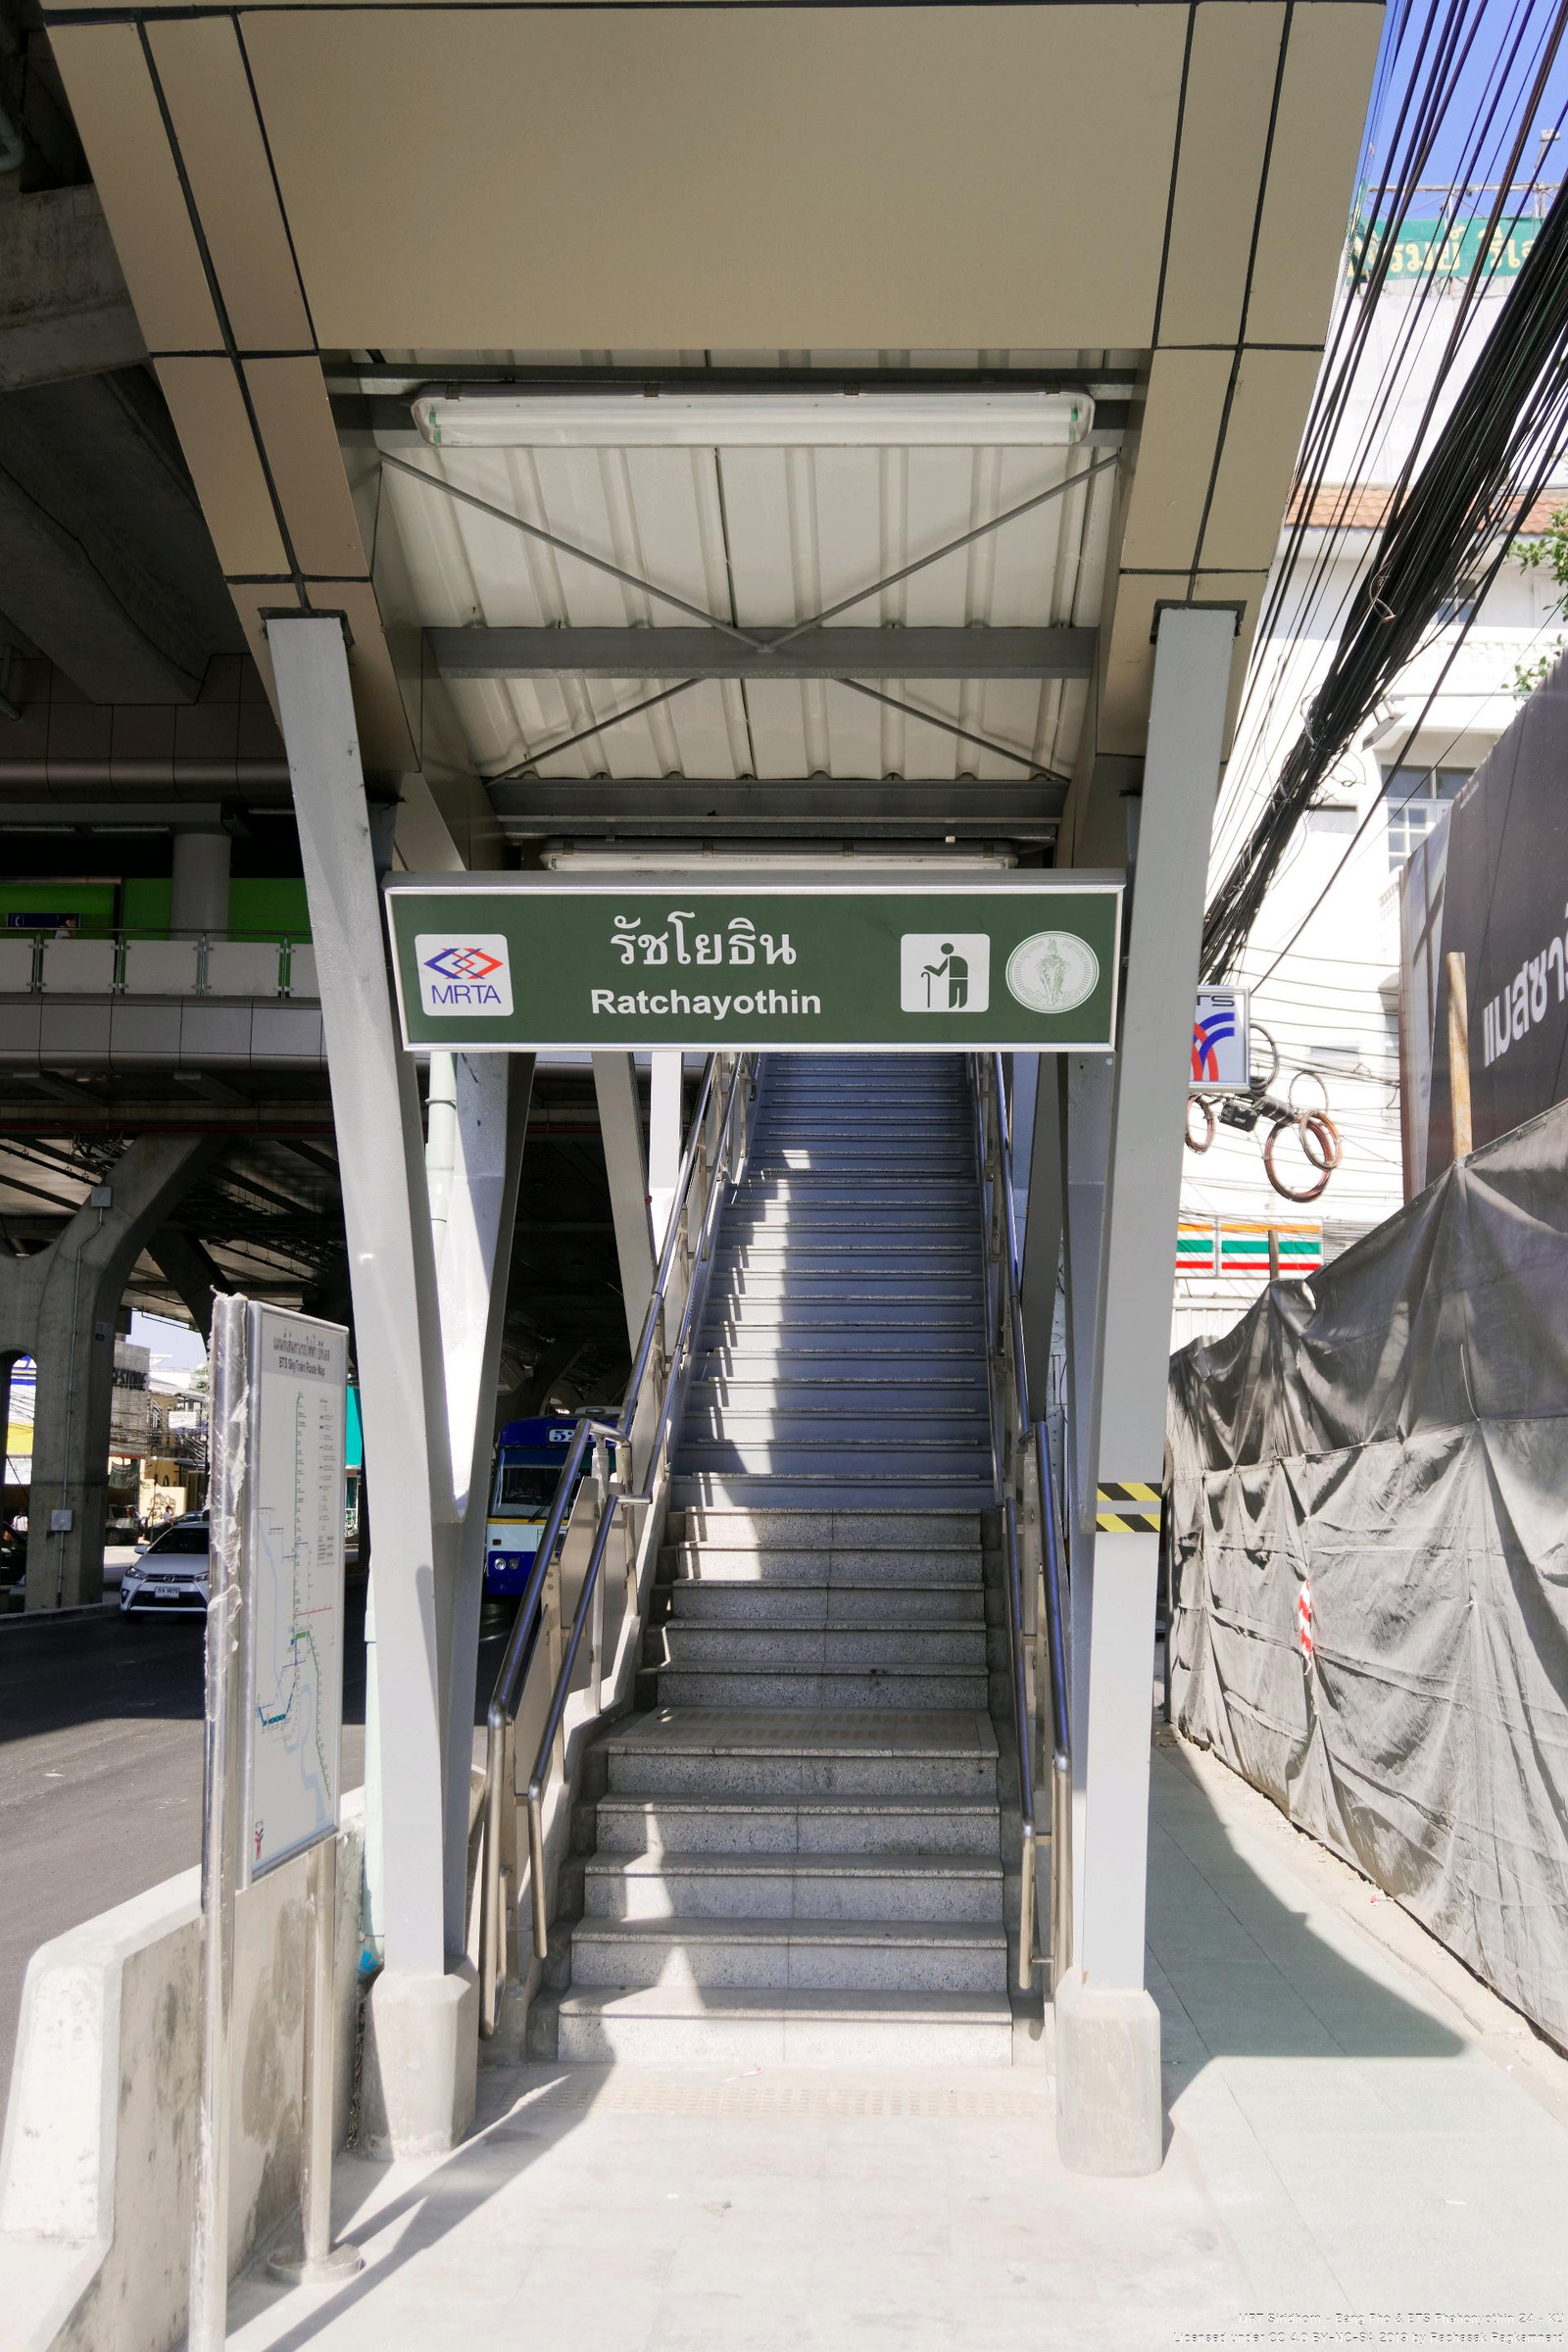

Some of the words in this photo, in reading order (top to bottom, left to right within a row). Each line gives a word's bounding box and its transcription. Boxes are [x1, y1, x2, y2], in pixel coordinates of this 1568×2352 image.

[610, 910, 797, 965] รัชโยธิน
[431, 984, 502, 1004] MRTA
[591, 989, 821, 1020] Ratchayothin
